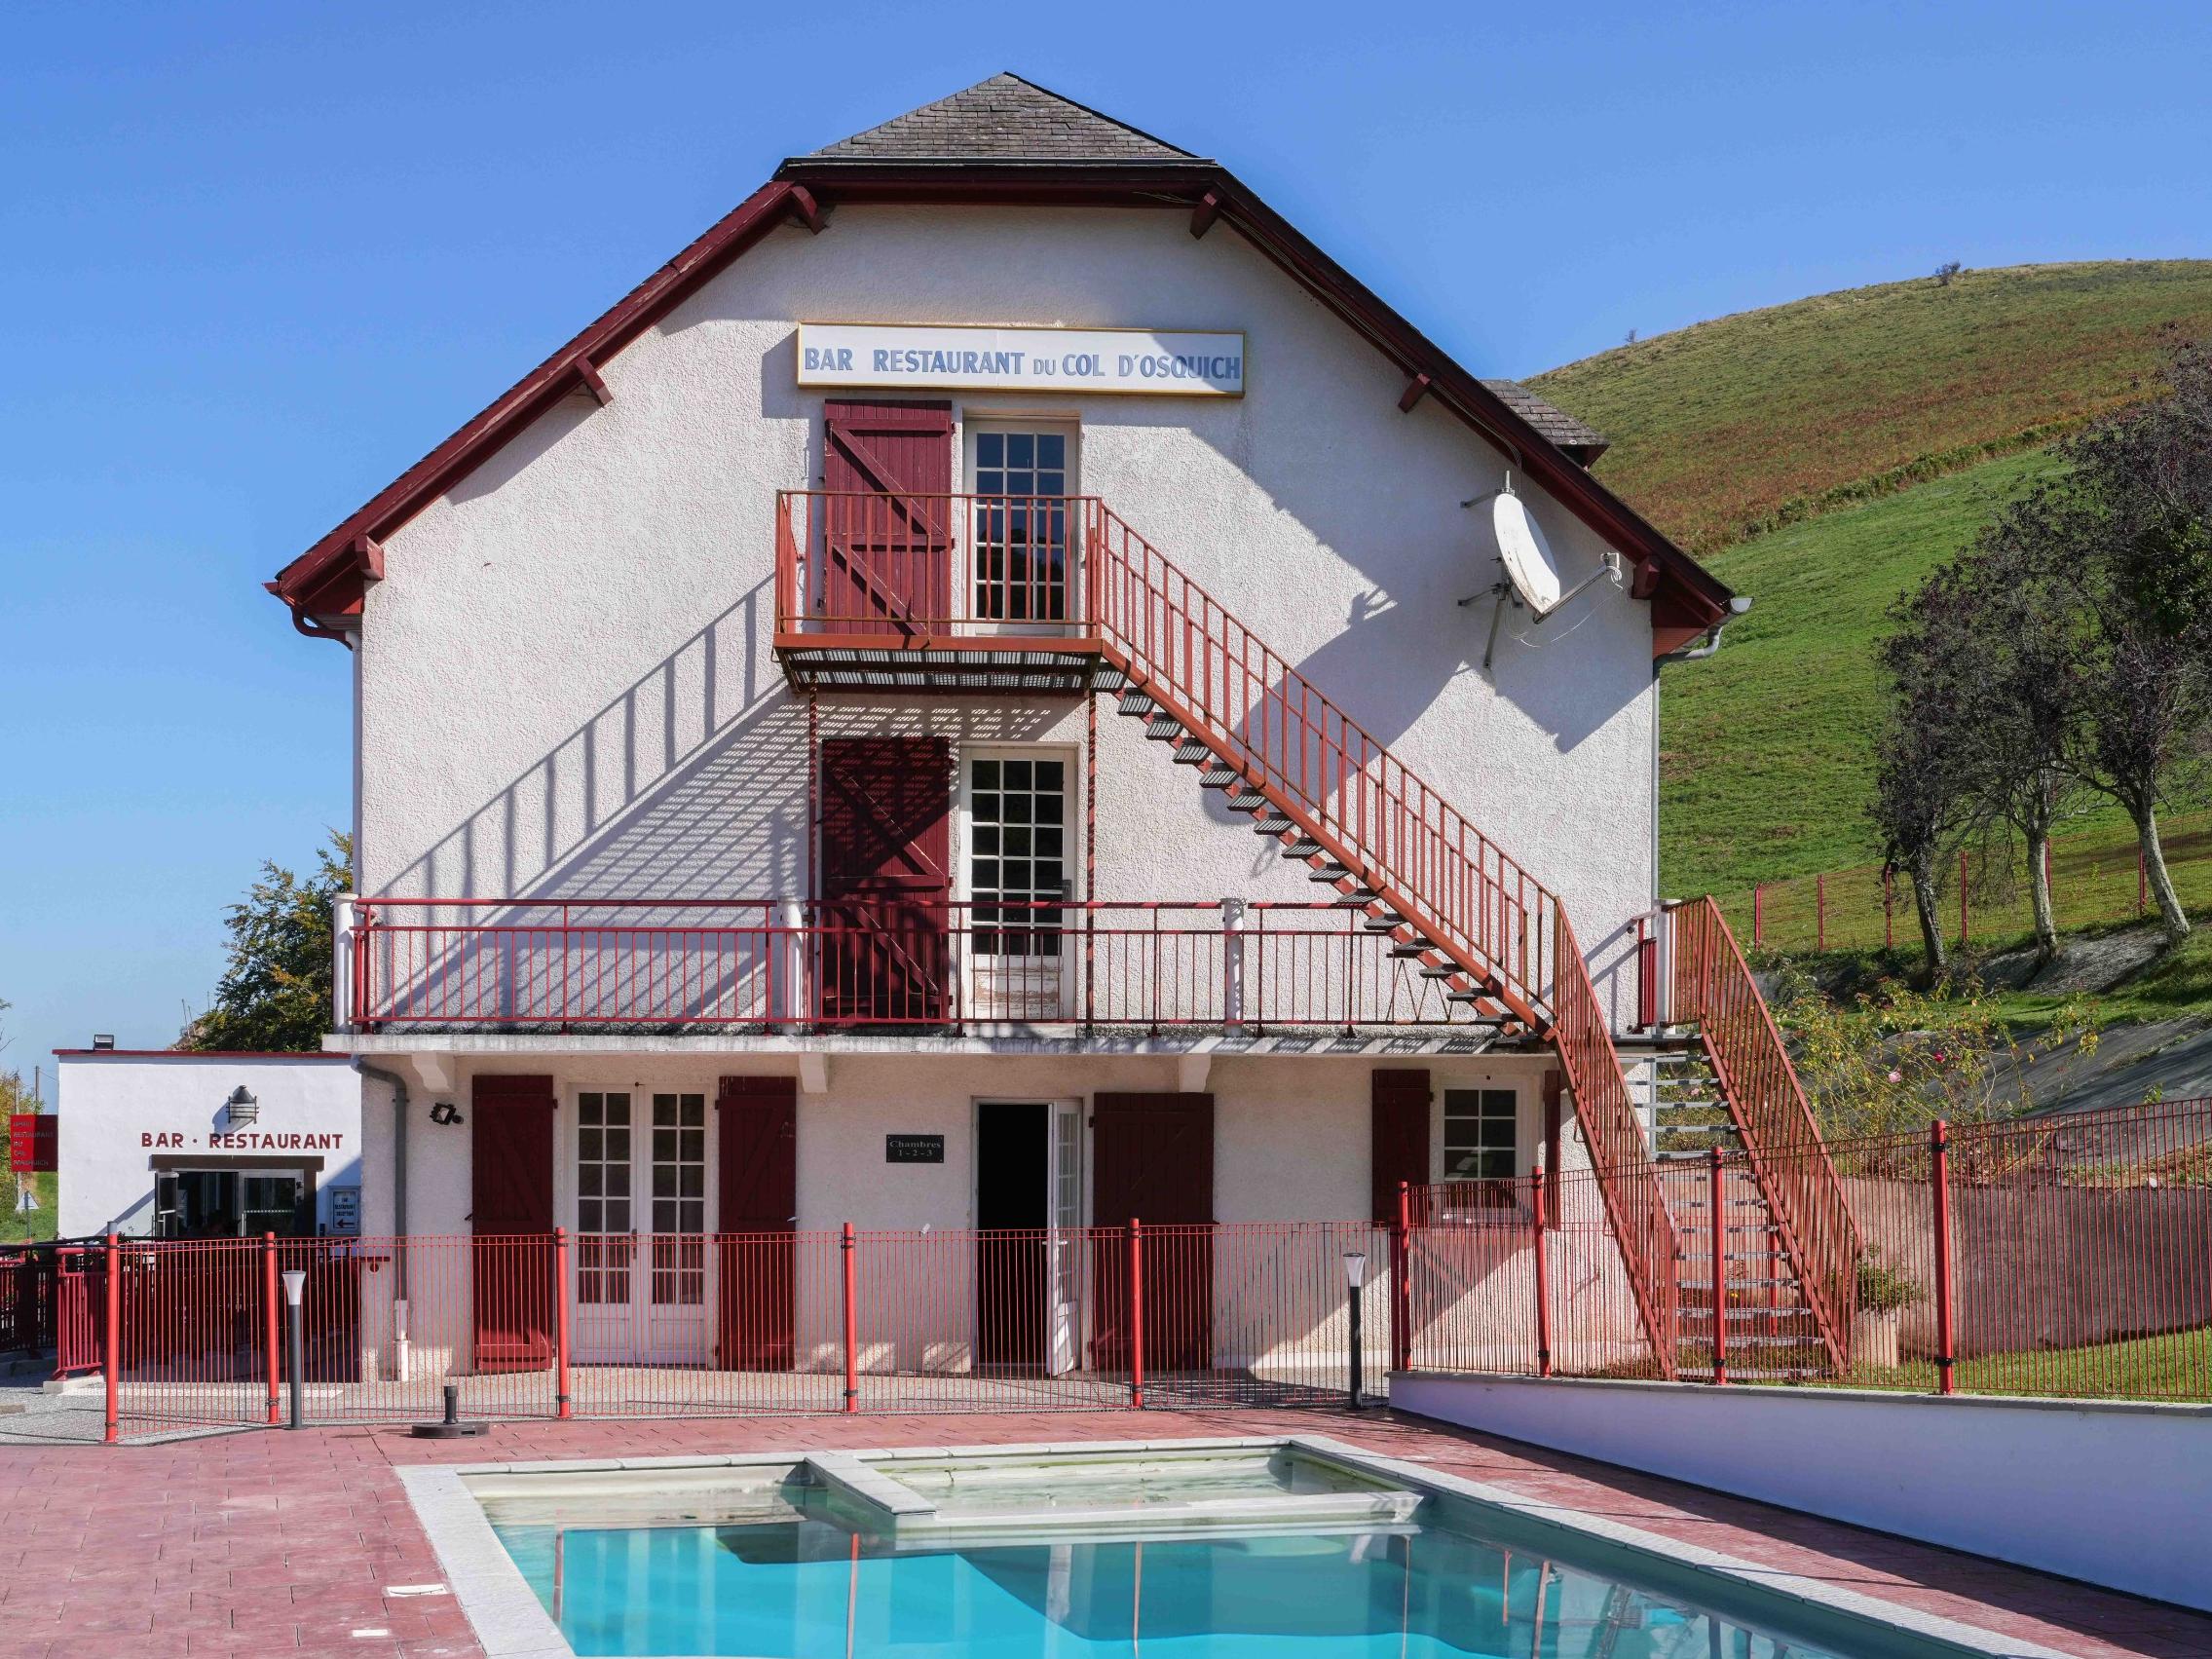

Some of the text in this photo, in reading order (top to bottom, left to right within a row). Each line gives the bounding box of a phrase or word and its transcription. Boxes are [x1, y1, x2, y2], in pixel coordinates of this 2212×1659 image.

[805, 348, 1241, 380] BAR RESTAURANT DU COL D'OSQUICH
[141, 1132, 344, 1150] BAR RESTAURANT
[889, 1140, 941, 1149] Chambres
